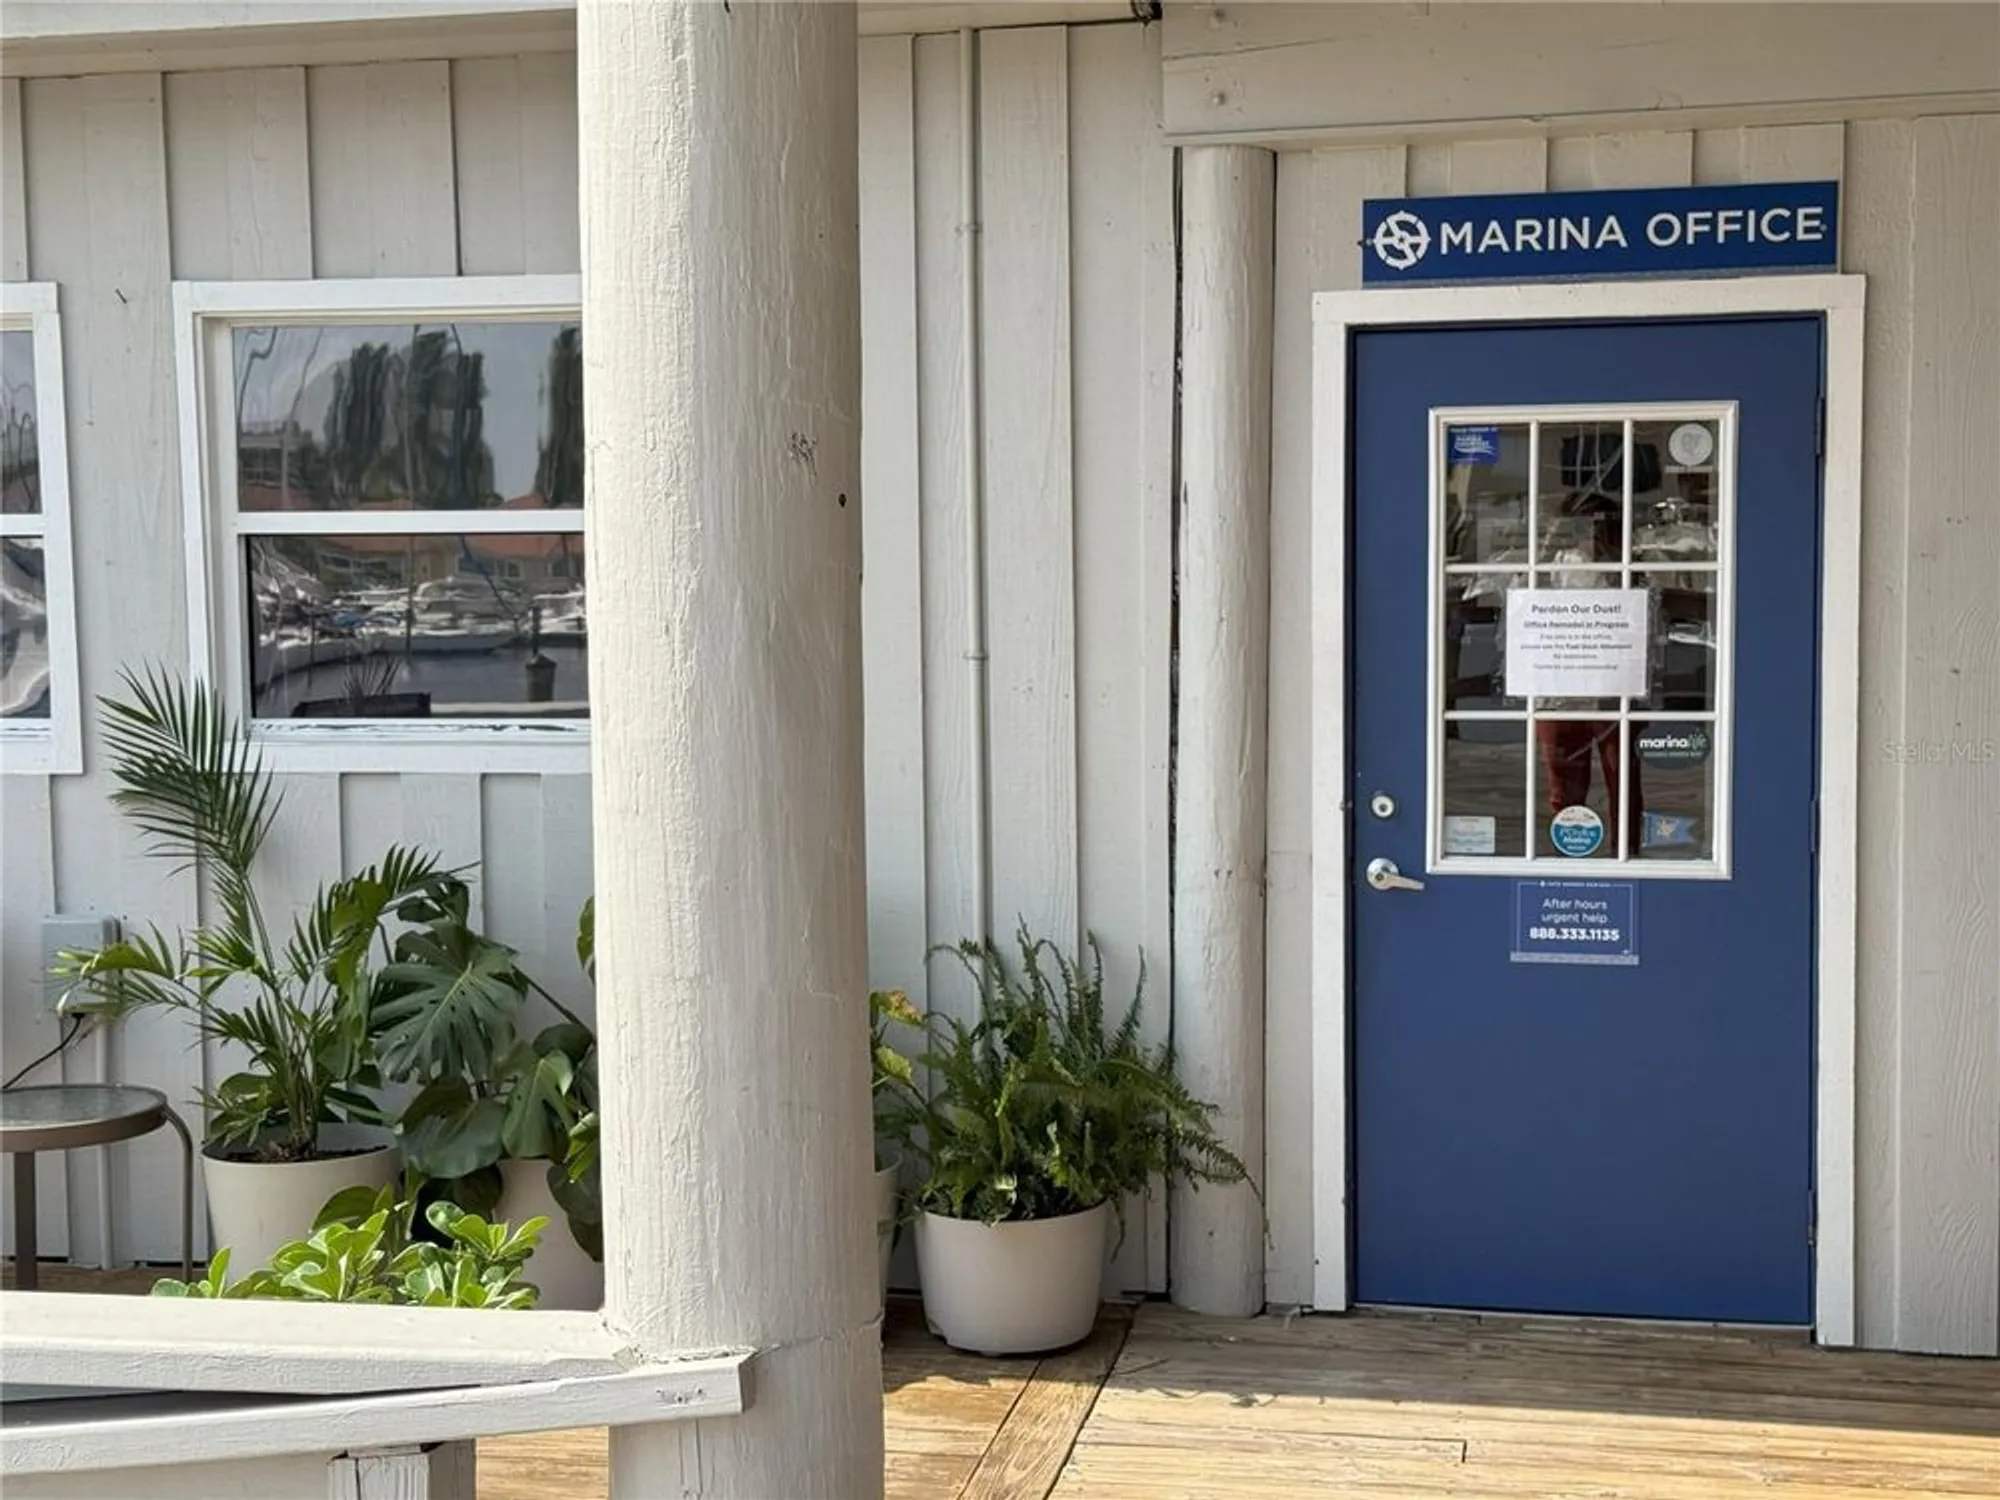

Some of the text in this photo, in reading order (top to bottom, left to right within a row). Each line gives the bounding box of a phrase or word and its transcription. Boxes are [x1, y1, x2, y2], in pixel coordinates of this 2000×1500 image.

[1440, 207, 1824, 255] MARINA OFFICE
[1532, 604, 1622, 614] Pardon Our Dust!
[1524, 621, 1547, 629] Office
[1594, 621, 1629, 630] Progress
[1542, 898, 1608, 910] After hours
[1541, 912, 1608, 924] urgent help
[1529, 927, 1620, 941] 888.333.1135
